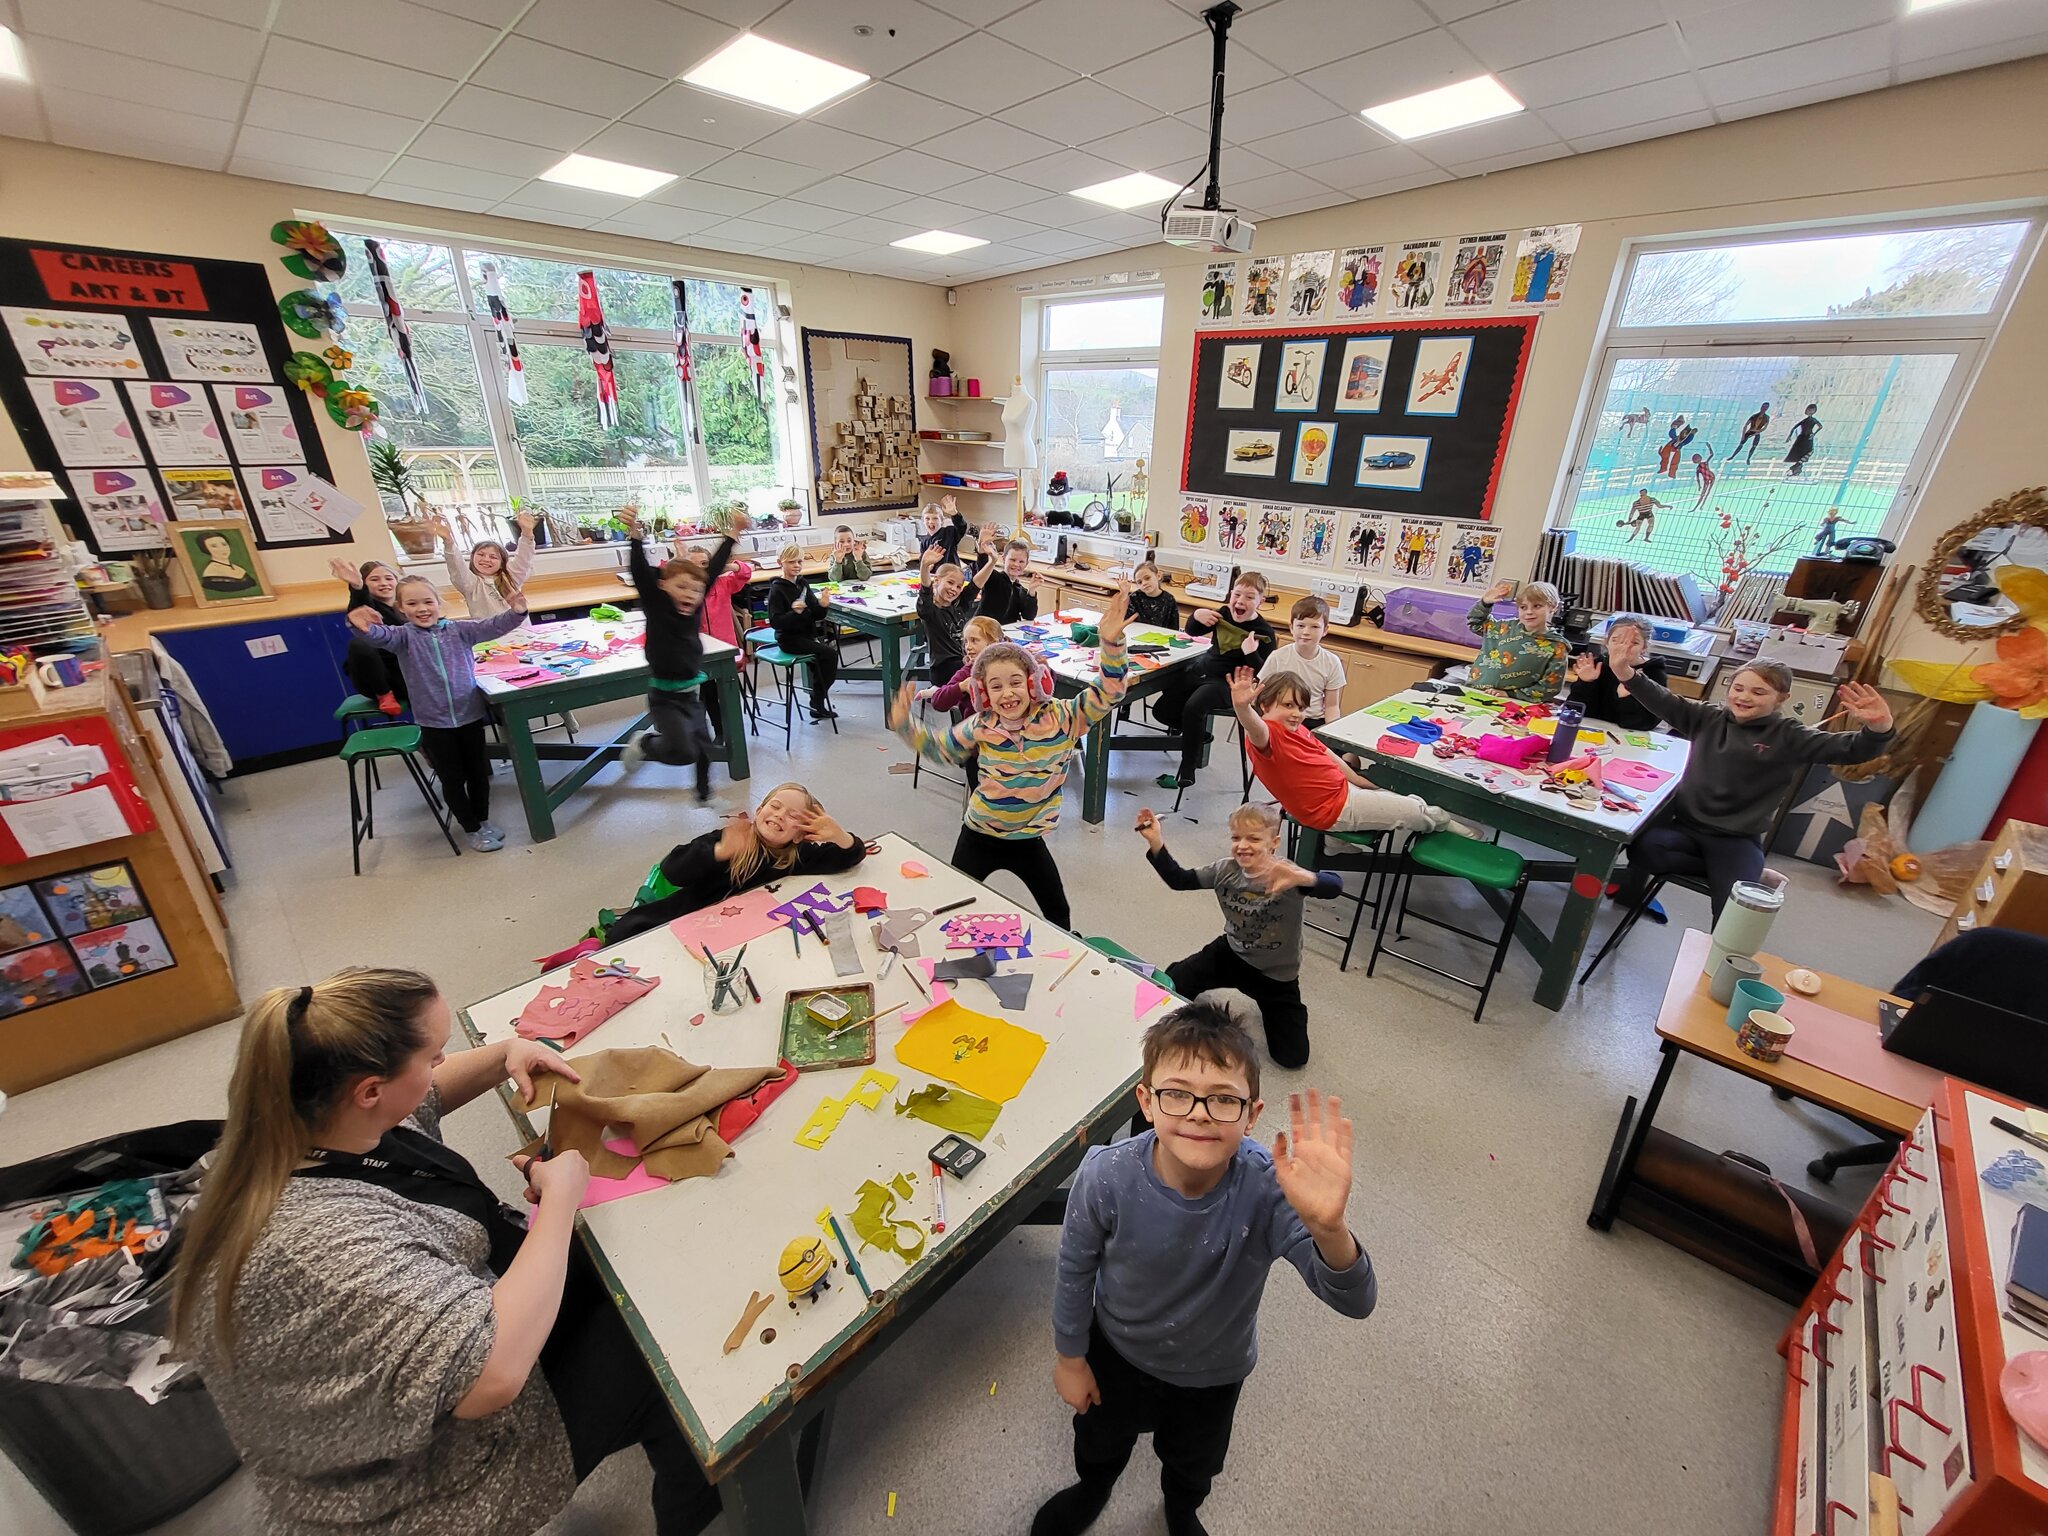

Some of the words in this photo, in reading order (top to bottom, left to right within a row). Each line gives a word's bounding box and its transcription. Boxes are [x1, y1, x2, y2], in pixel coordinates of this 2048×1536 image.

[1459, 236, 1478, 244] ESTHER
[60, 253, 174, 278] CAREERS
[69, 281, 119, 300] ART
[129, 286, 147, 302] &
[153, 288, 184, 305] DT
[1222, 888, 1228, 896] I
[362, 1157, 389, 1169] STAFF
